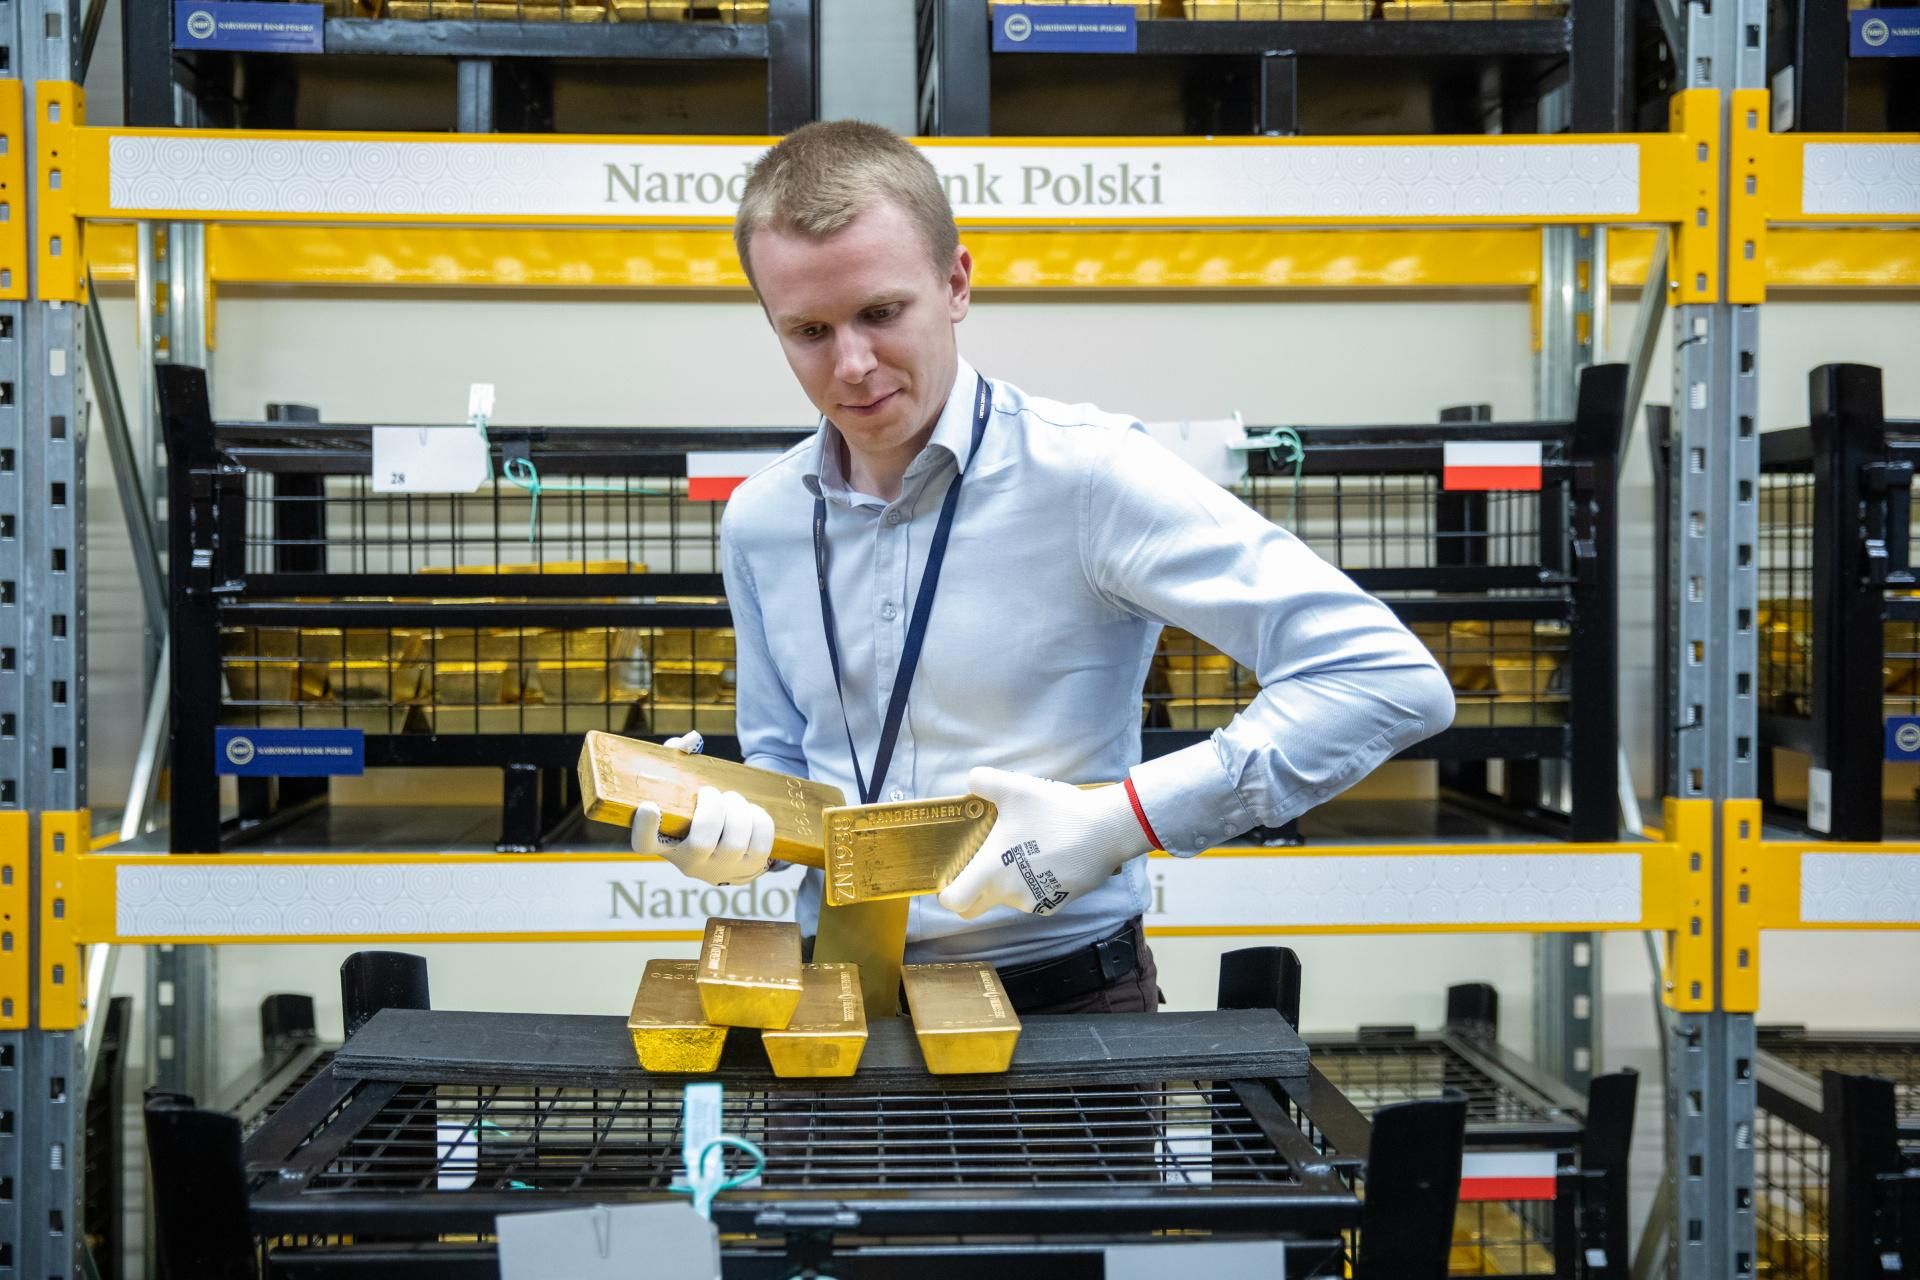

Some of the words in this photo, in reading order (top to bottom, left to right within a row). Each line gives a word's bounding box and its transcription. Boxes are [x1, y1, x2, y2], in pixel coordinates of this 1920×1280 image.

[1020, 162, 1164, 206] Polski
[1001, 849, 1014, 866] 8
[607, 879, 798, 919] Narodo
